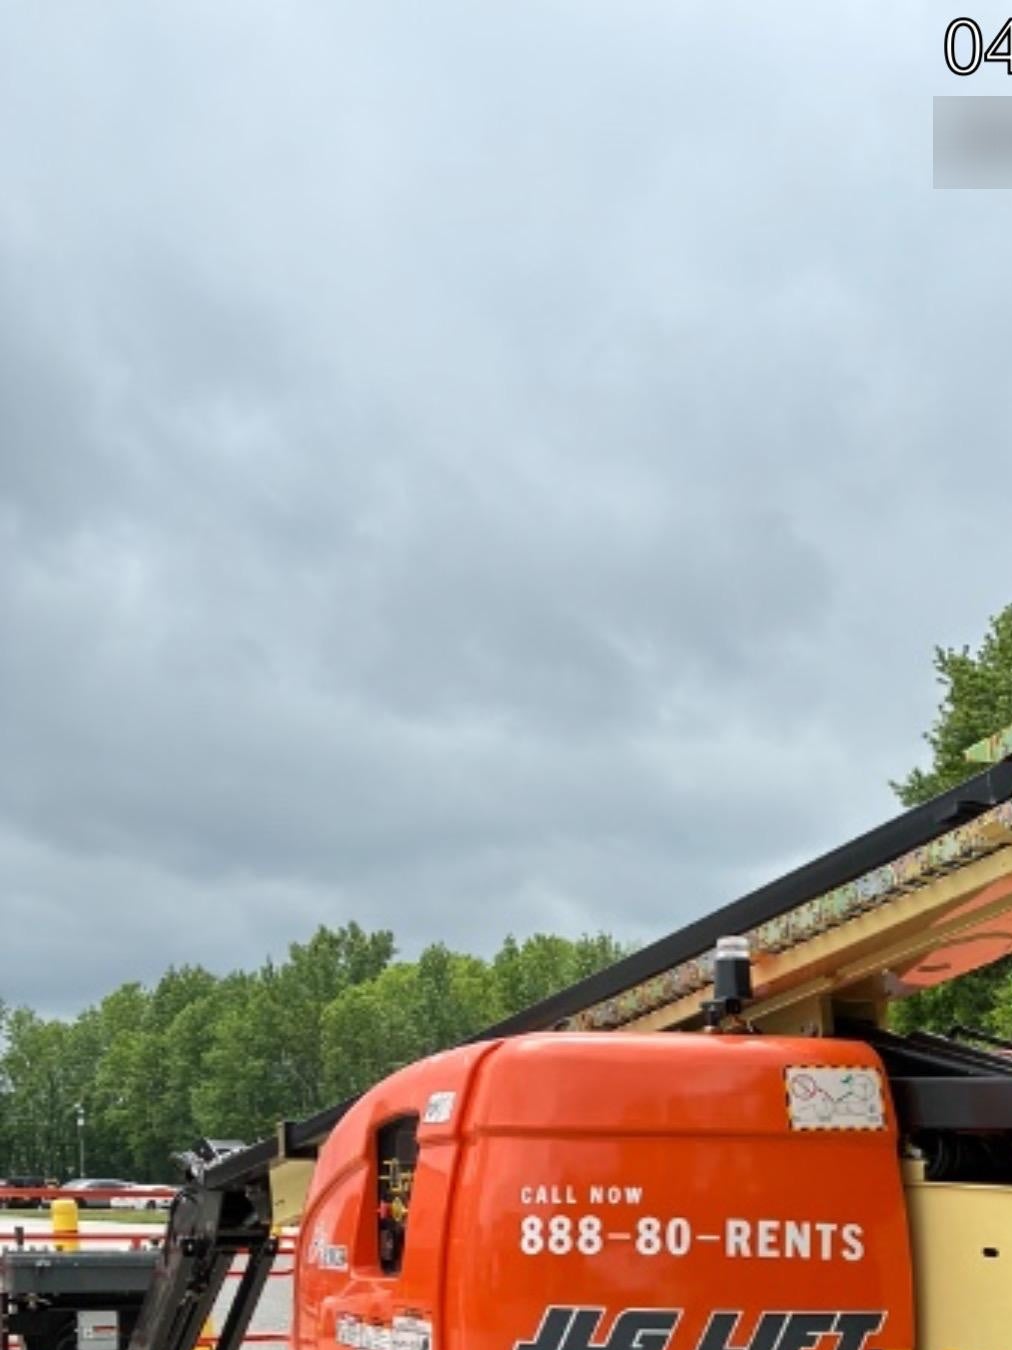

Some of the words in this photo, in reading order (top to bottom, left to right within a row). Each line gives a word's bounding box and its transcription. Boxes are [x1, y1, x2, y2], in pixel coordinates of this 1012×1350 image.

[520, 1185, 577, 1205] CALL
[589, 1186, 643, 1205] NOW
[519, 1214, 865, 1262] 888-80-RENTS
